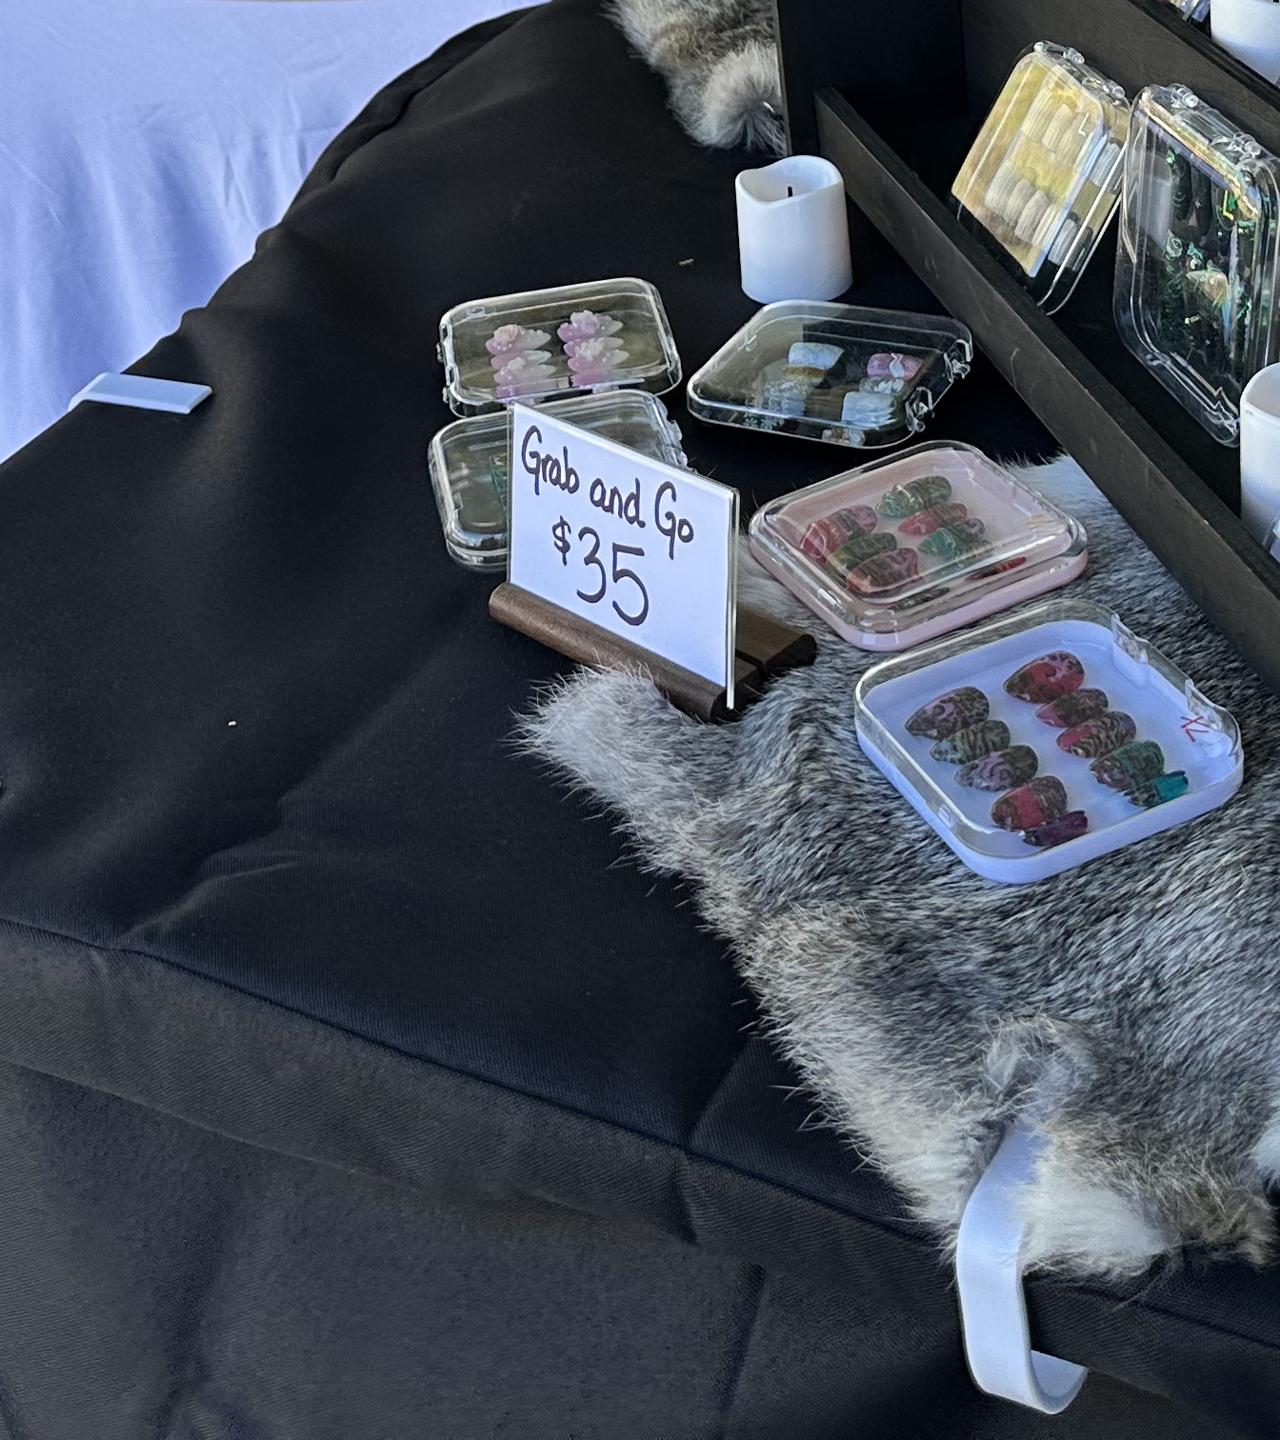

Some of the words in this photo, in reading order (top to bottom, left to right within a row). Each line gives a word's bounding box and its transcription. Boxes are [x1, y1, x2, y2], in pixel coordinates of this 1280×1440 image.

[1077, 111, 1087, 137] L
[520, 424, 580, 496] Grab
[589, 477, 646, 529] and
[653, 479, 695, 560] Go
[551, 515, 650, 626] $35
[1180, 715, 1210, 743] XL
